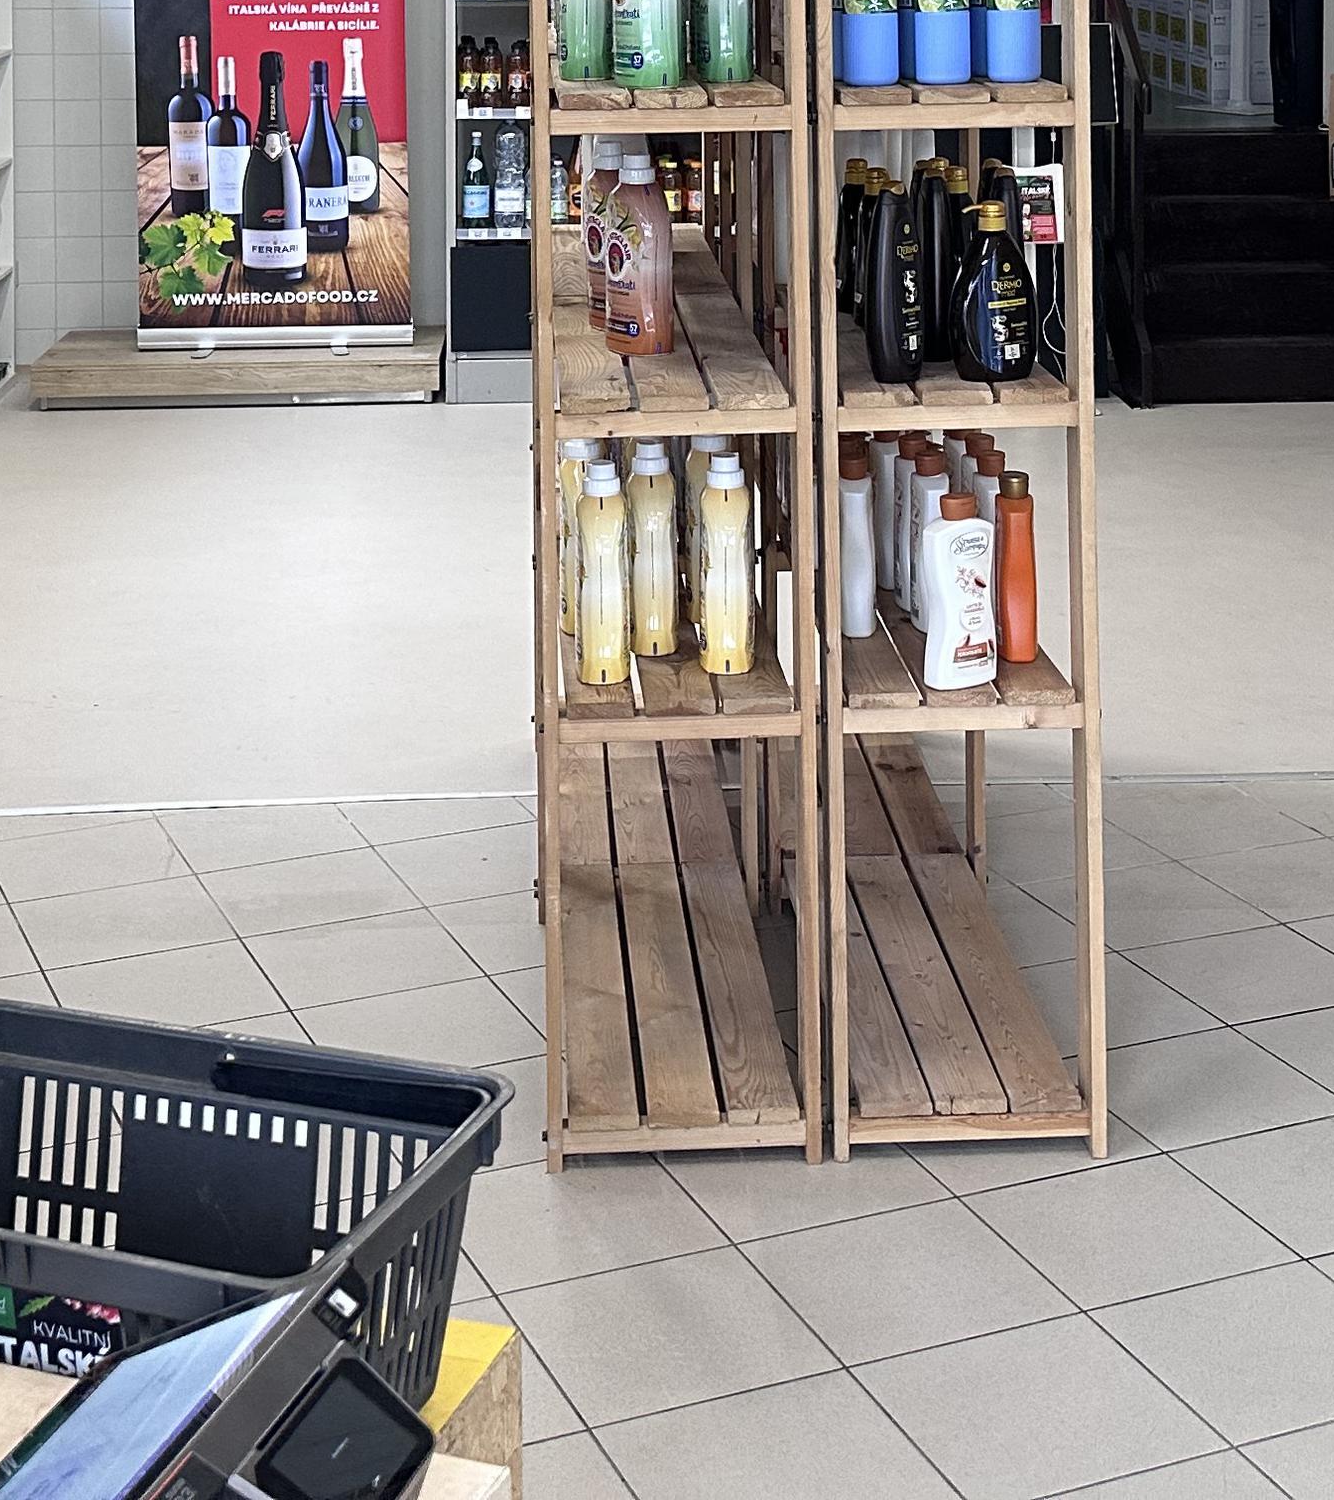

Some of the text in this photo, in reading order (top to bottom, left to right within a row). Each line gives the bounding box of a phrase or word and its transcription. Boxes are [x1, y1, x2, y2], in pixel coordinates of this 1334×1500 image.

[228, 2, 379, 15] ITALSKÁ VÍNA PŘEVÁŽNĚ Z
[269, 18, 380, 31] KALÁBRIE A SICÍLIE.
[251, 243, 298, 255] FERRARI
[172, 289, 379, 307] WWW.MERCADOFOOD.CZ
[33, 1320, 111, 1350] KVALITNÍ
